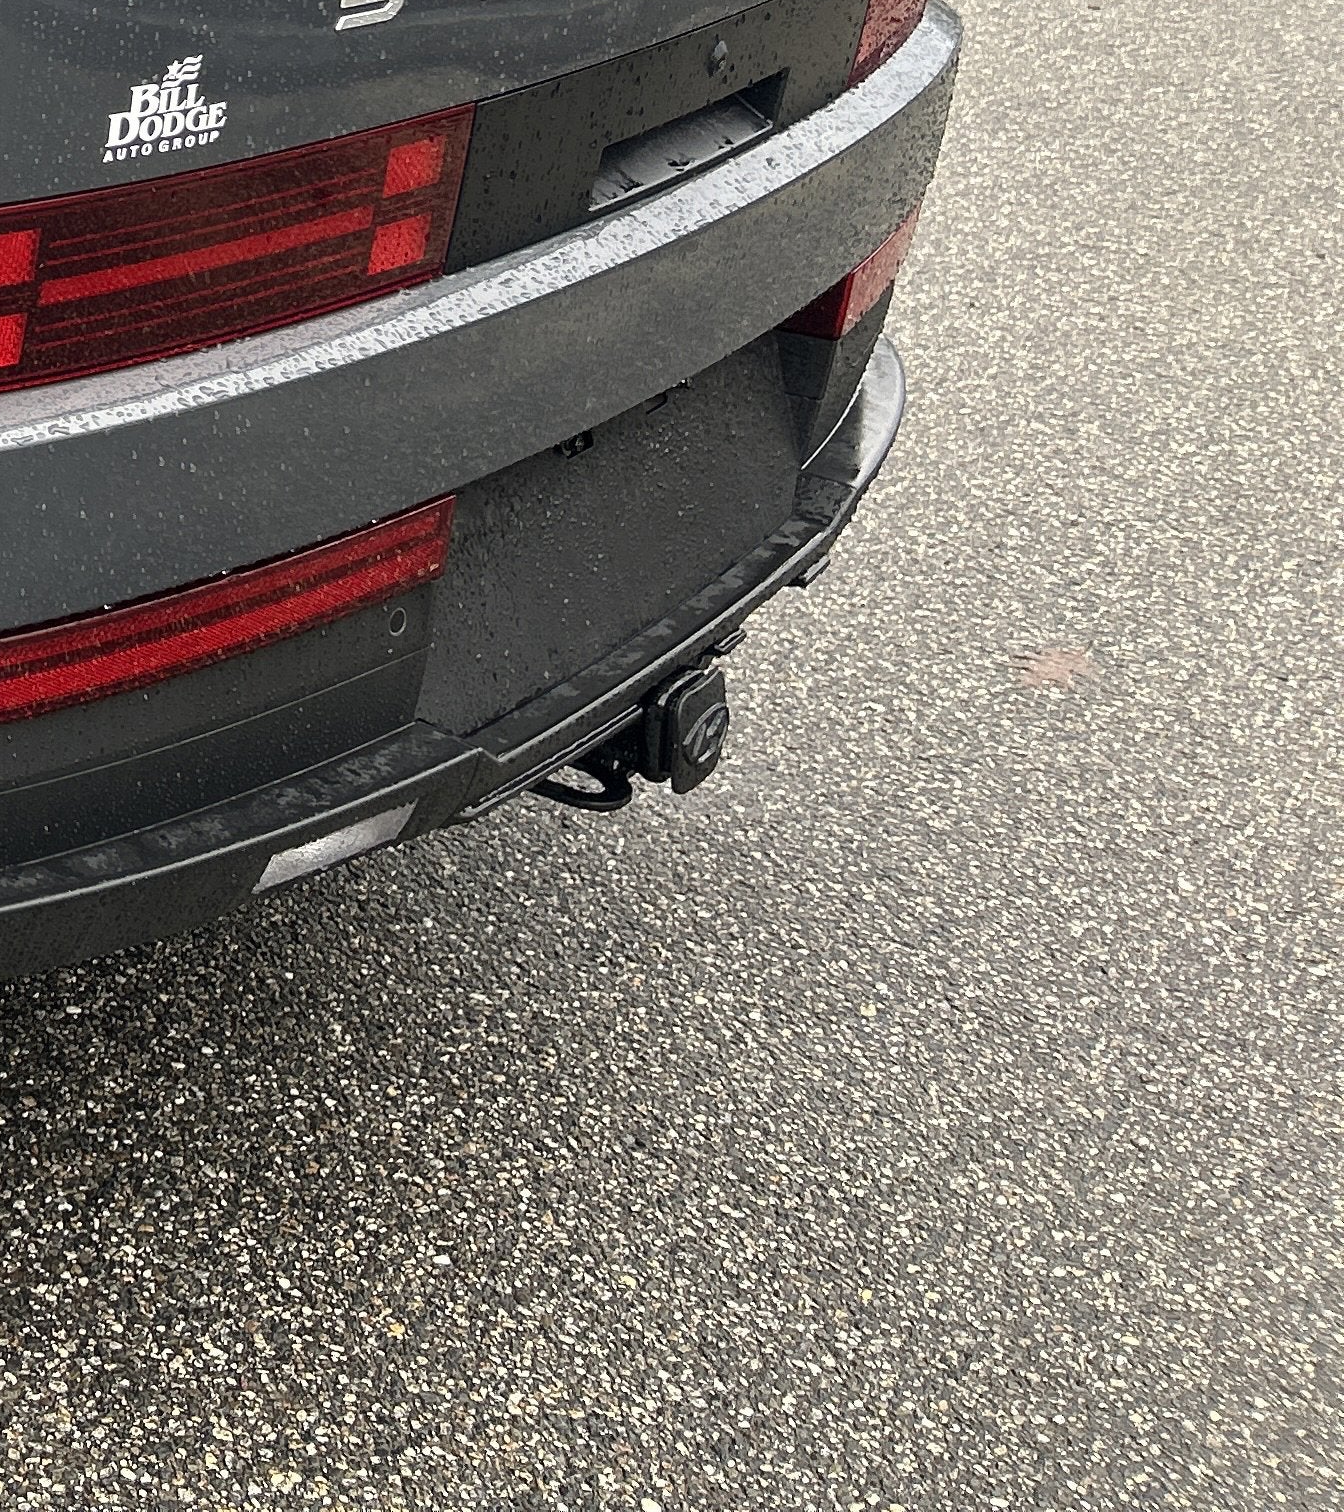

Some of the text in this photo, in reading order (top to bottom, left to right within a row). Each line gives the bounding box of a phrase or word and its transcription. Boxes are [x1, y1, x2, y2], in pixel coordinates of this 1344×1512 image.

[130, 84, 205, 118] BILL
[105, 102, 227, 148] DODGE
[103, 131, 220, 163] AUTO GROUP
